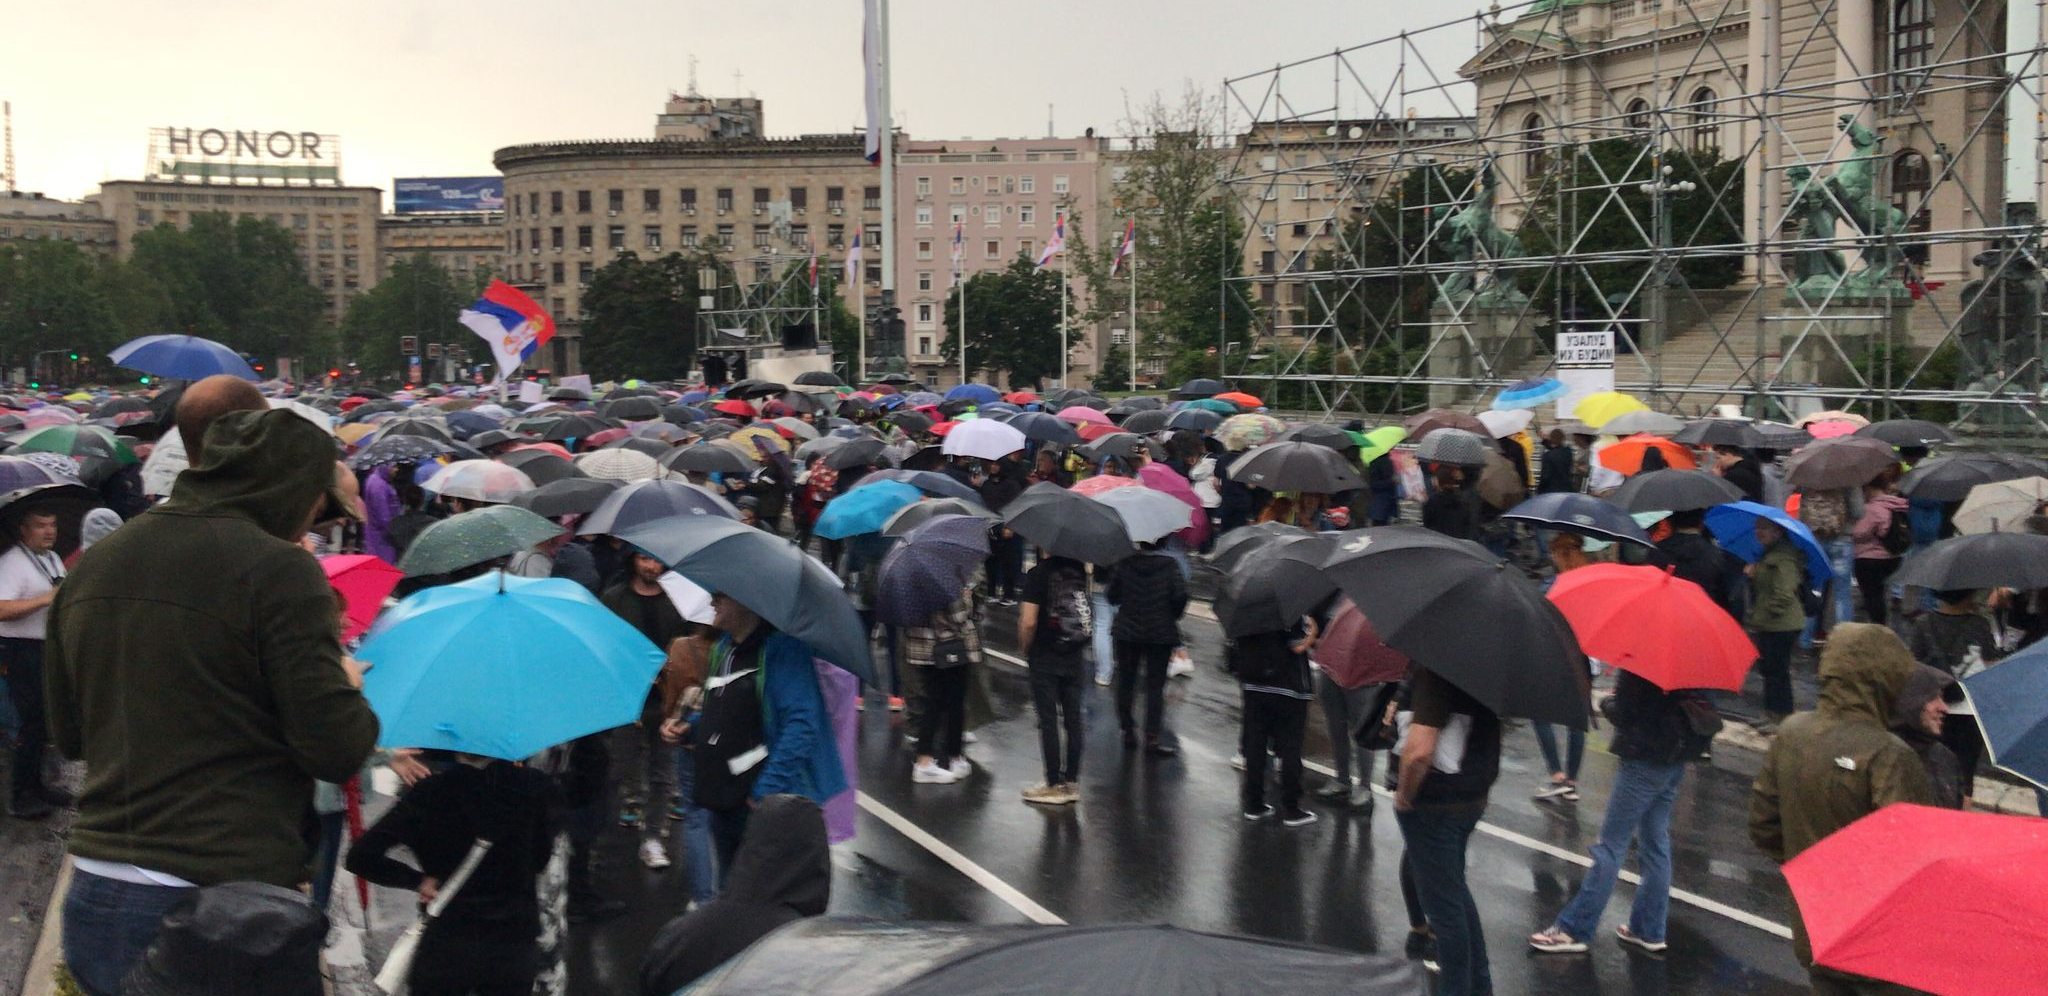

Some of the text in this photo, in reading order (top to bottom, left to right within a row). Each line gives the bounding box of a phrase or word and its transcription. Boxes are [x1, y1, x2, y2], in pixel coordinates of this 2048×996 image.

[168, 126, 323, 159] HONOR
[1566, 335, 1607, 347] УЗАЛУД
[1560, 349, 1613, 361] ИХ БУДИМ
